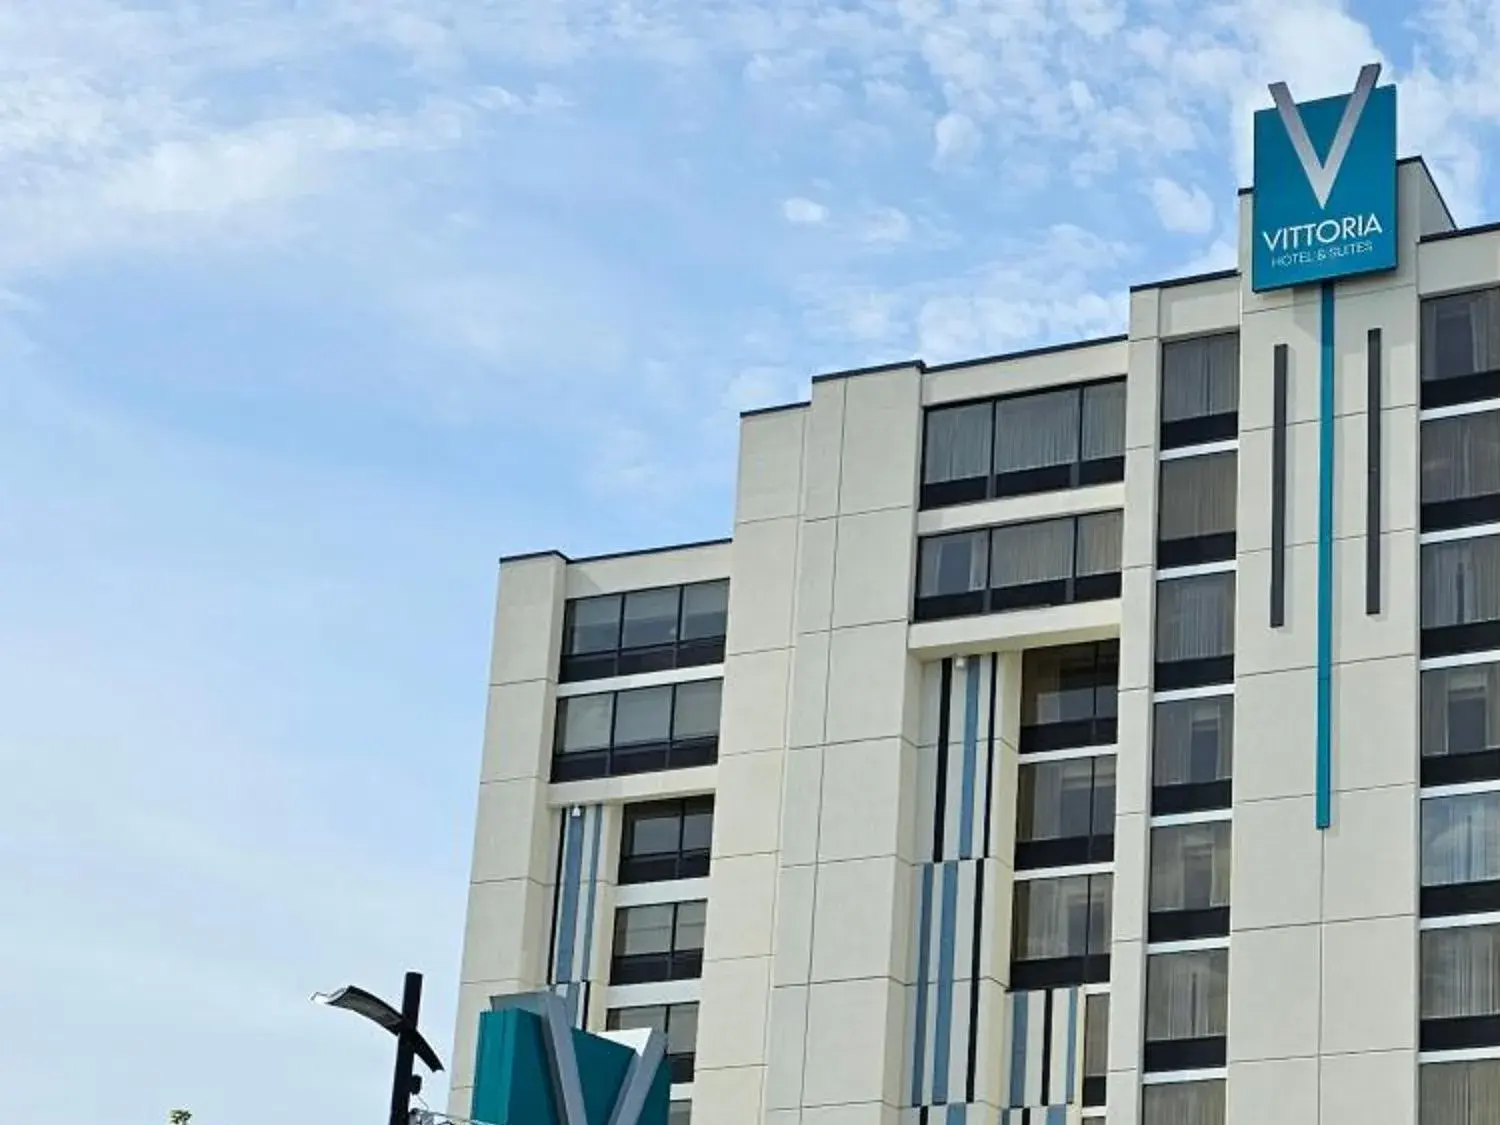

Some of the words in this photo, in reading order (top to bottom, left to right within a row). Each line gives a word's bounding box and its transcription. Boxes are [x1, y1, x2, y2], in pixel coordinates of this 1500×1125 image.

[1263, 212, 1383, 251] VITTORIA
[1271, 251, 1311, 268] HOTEL
[1317, 248, 1327, 261] &
[1329, 240, 1373, 257] SUITES
